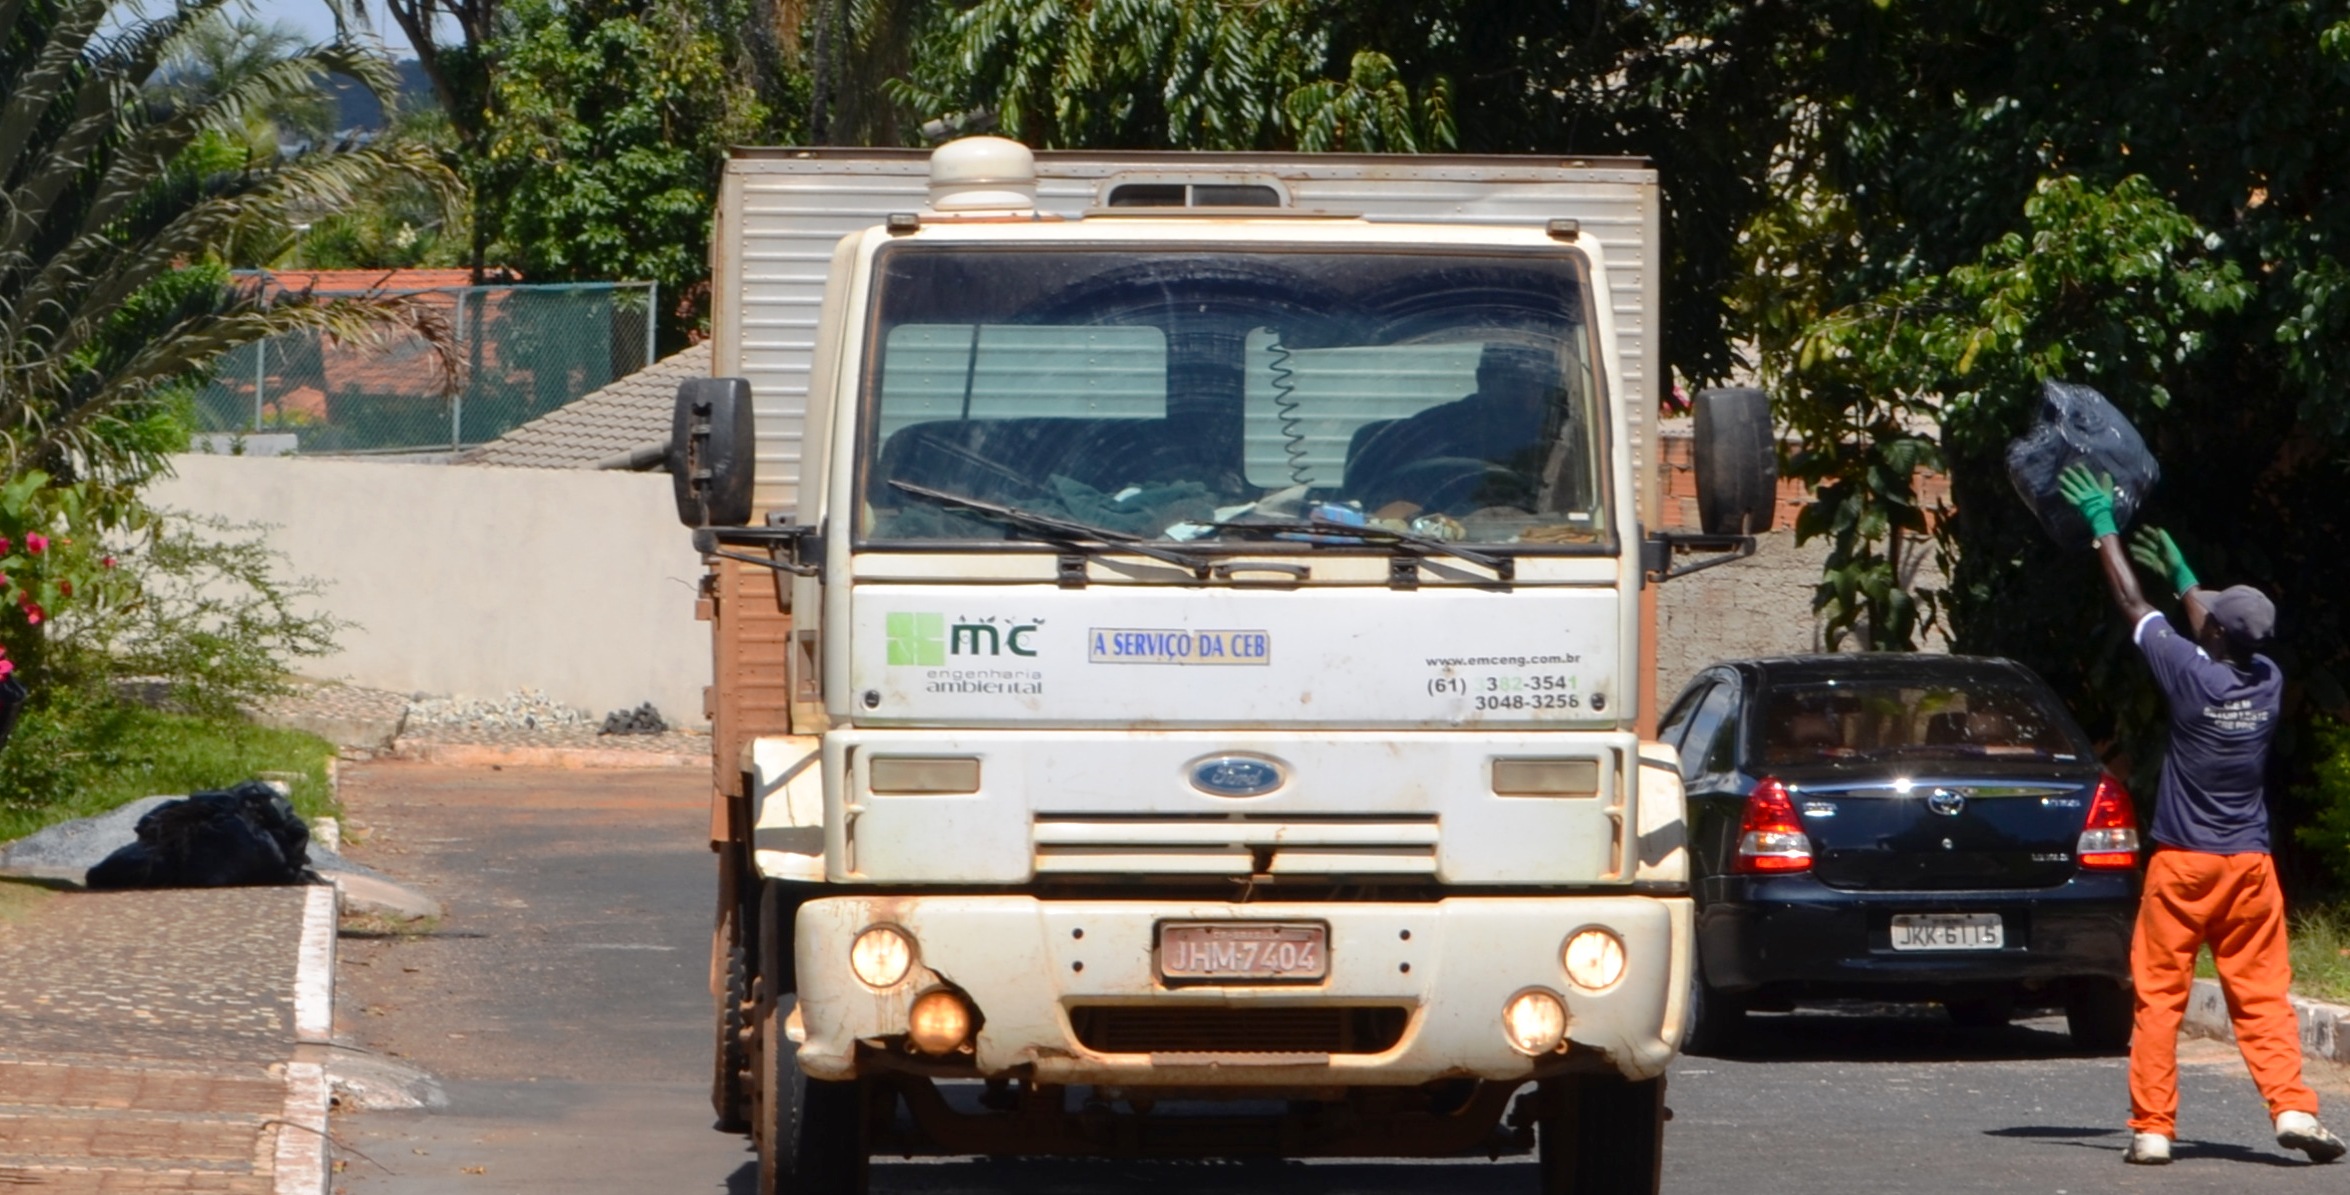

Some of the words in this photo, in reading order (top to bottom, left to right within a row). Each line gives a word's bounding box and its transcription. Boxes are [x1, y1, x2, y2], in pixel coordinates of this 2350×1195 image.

[1093, 632, 1107, 655] A
[1113, 633, 1191, 661] SERVIÇO
[1199, 634, 1224, 657] DA
[1231, 634, 1265, 657] CEB
[1425, 653, 1581, 667] www.emceng.com.br
[926, 669, 1043, 680] engenharia
[926, 680, 1043, 694] ambiental
[1427, 677, 1467, 697] (61)
[1172, 941, 1316, 971] JHM-7404
